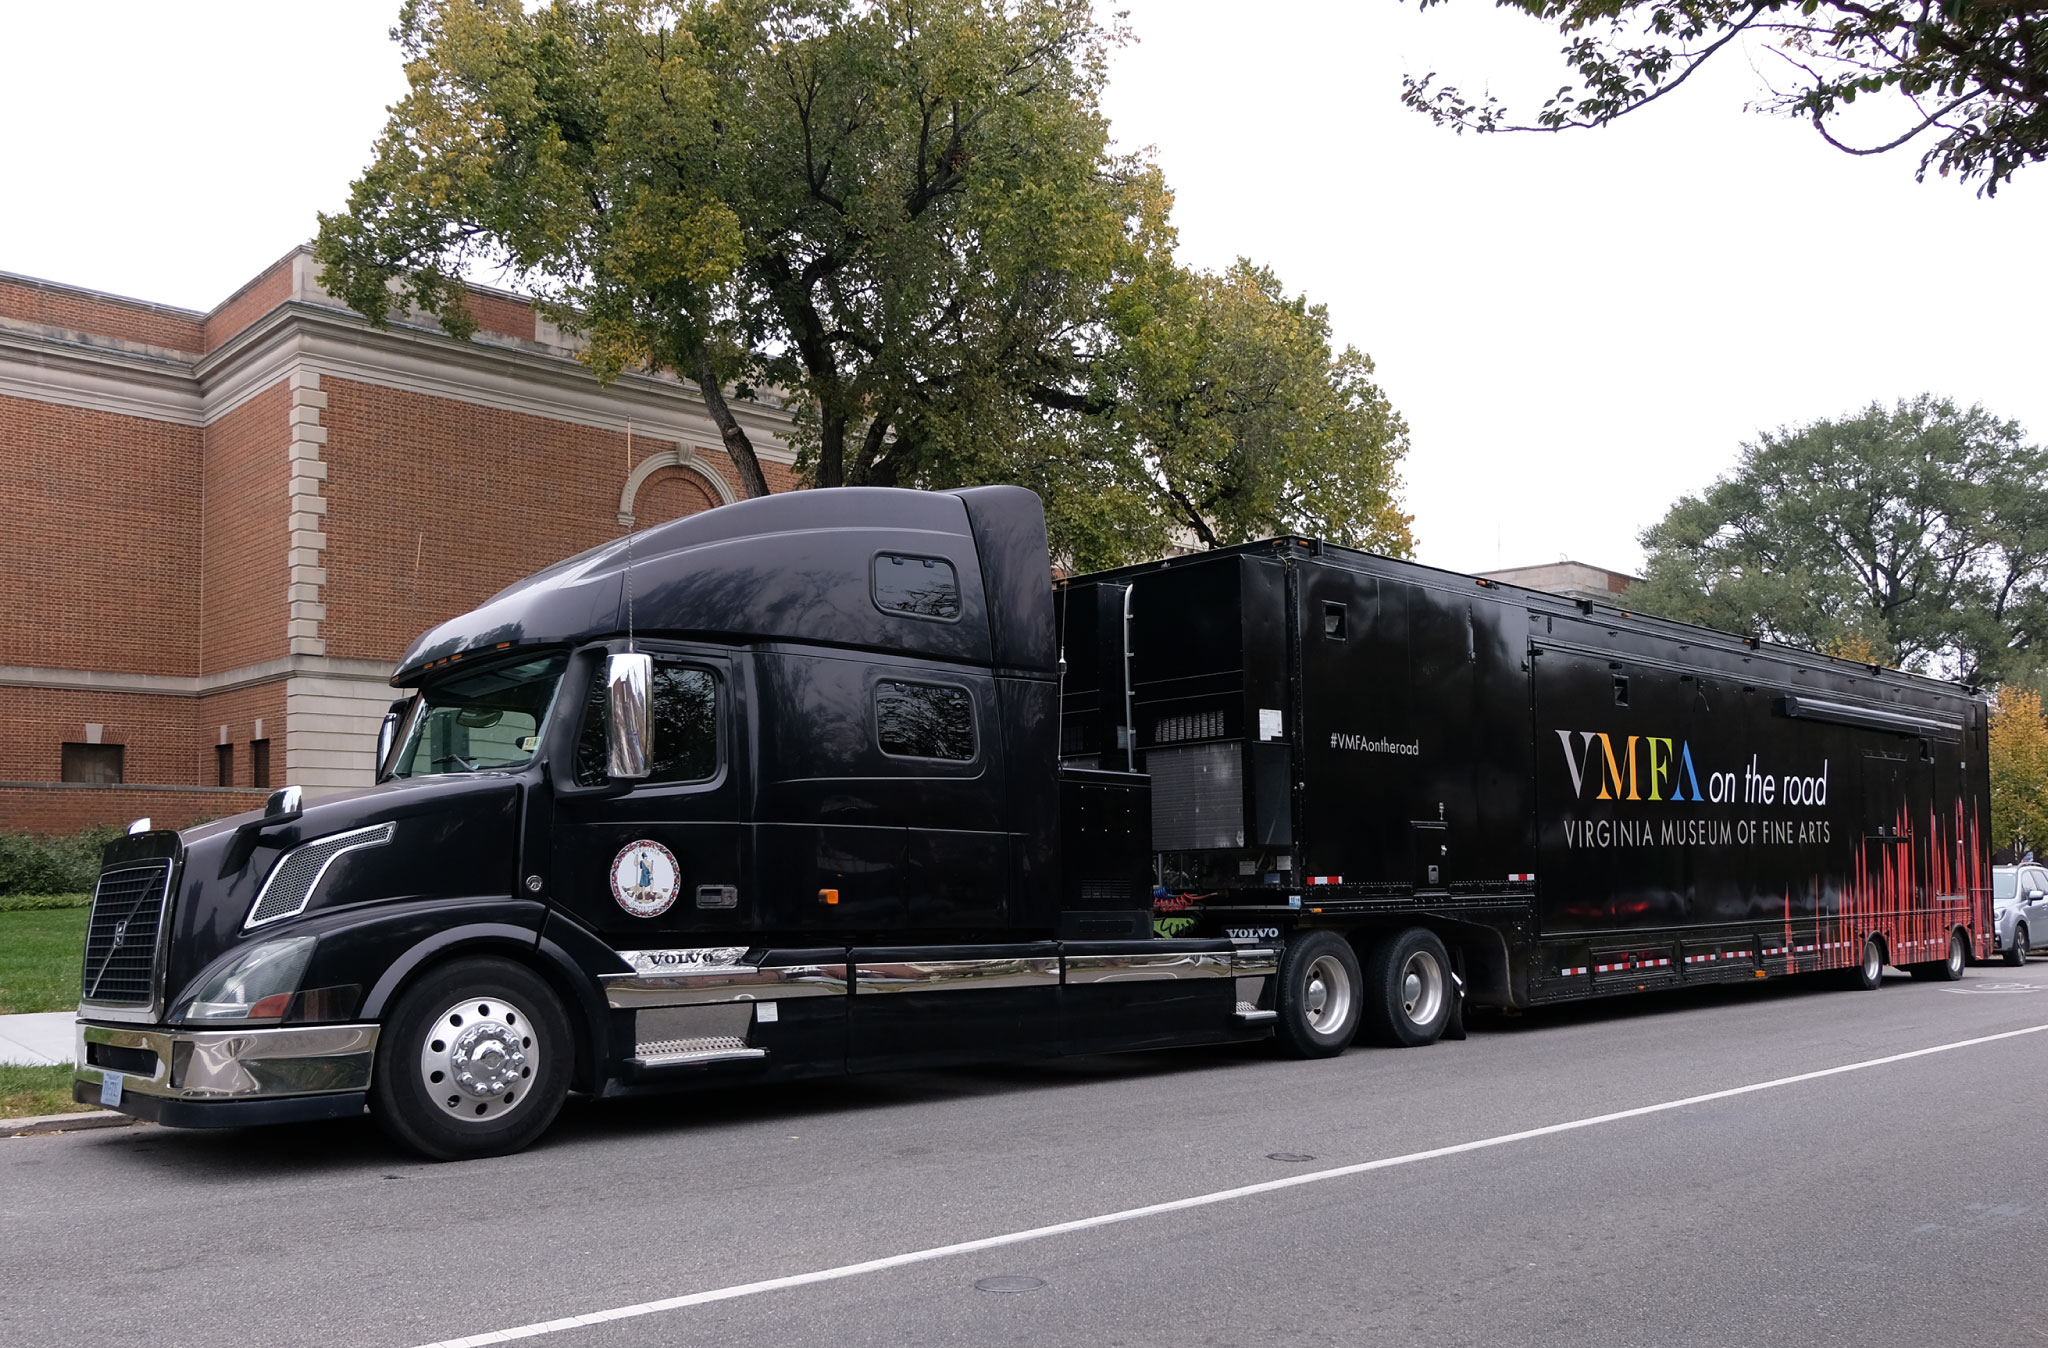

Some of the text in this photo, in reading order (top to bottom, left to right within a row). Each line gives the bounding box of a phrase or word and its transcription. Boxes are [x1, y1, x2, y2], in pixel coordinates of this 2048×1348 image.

[1330, 732, 1419, 756] #VMFAontheroad
[1554, 729, 1828, 806] VMFA on the road
[1563, 819, 1831, 849] VIRGINIA MUSEUM OF FINE ARTS
[1226, 927, 1279, 938] VOLVO
[647, 952, 714, 965] VOLVO
